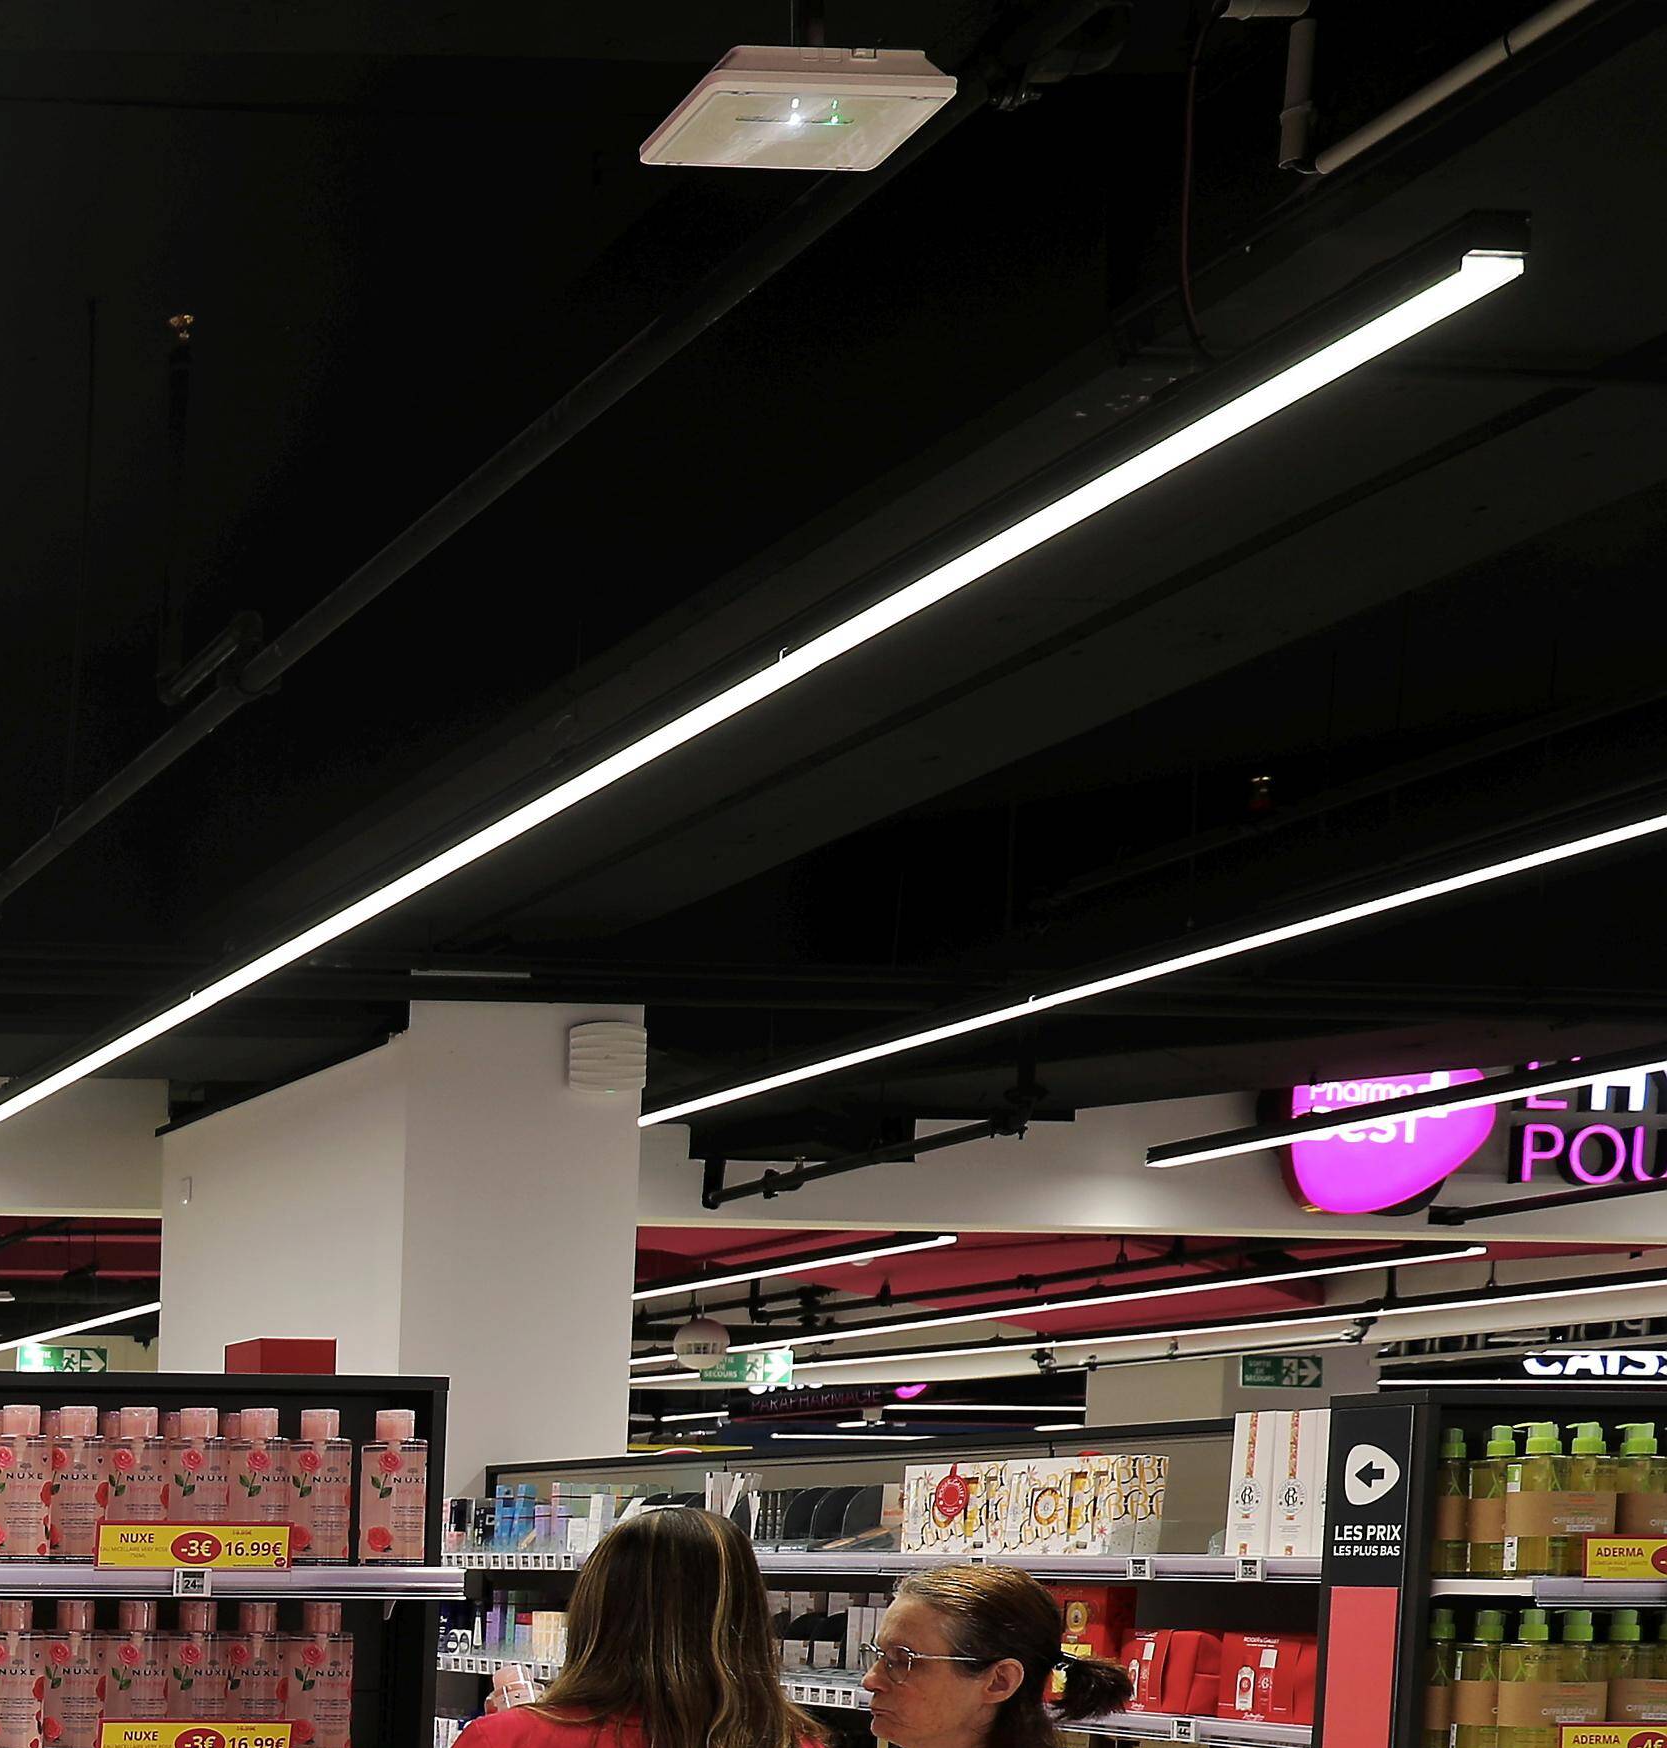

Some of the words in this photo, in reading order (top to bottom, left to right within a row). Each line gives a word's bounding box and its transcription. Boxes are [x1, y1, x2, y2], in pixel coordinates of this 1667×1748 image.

[704, 1369, 737, 1379] SECOURS
[1335, 1525, 1362, 1541] LES
[1366, 1524, 1402, 1541] PRIX
[120, 1533, 155, 1543] NUXE
[180, 1540, 213, 1557] -3€
[225, 1541, 283, 1557] 16.99€
[1333, 1545, 1351, 1556] LES
[1353, 1545, 1378, 1556] PLUS
[1380, 1545, 1400, 1556] BAS
[1596, 1547, 1644, 1557] ADERMA
[0, 1668, 37, 1676] NUXE
[63, 1668, 100, 1676] NUXE
[123, 1731, 159, 1741] NUXE
[1573, 1735, 1620, 1744] ADERMA
